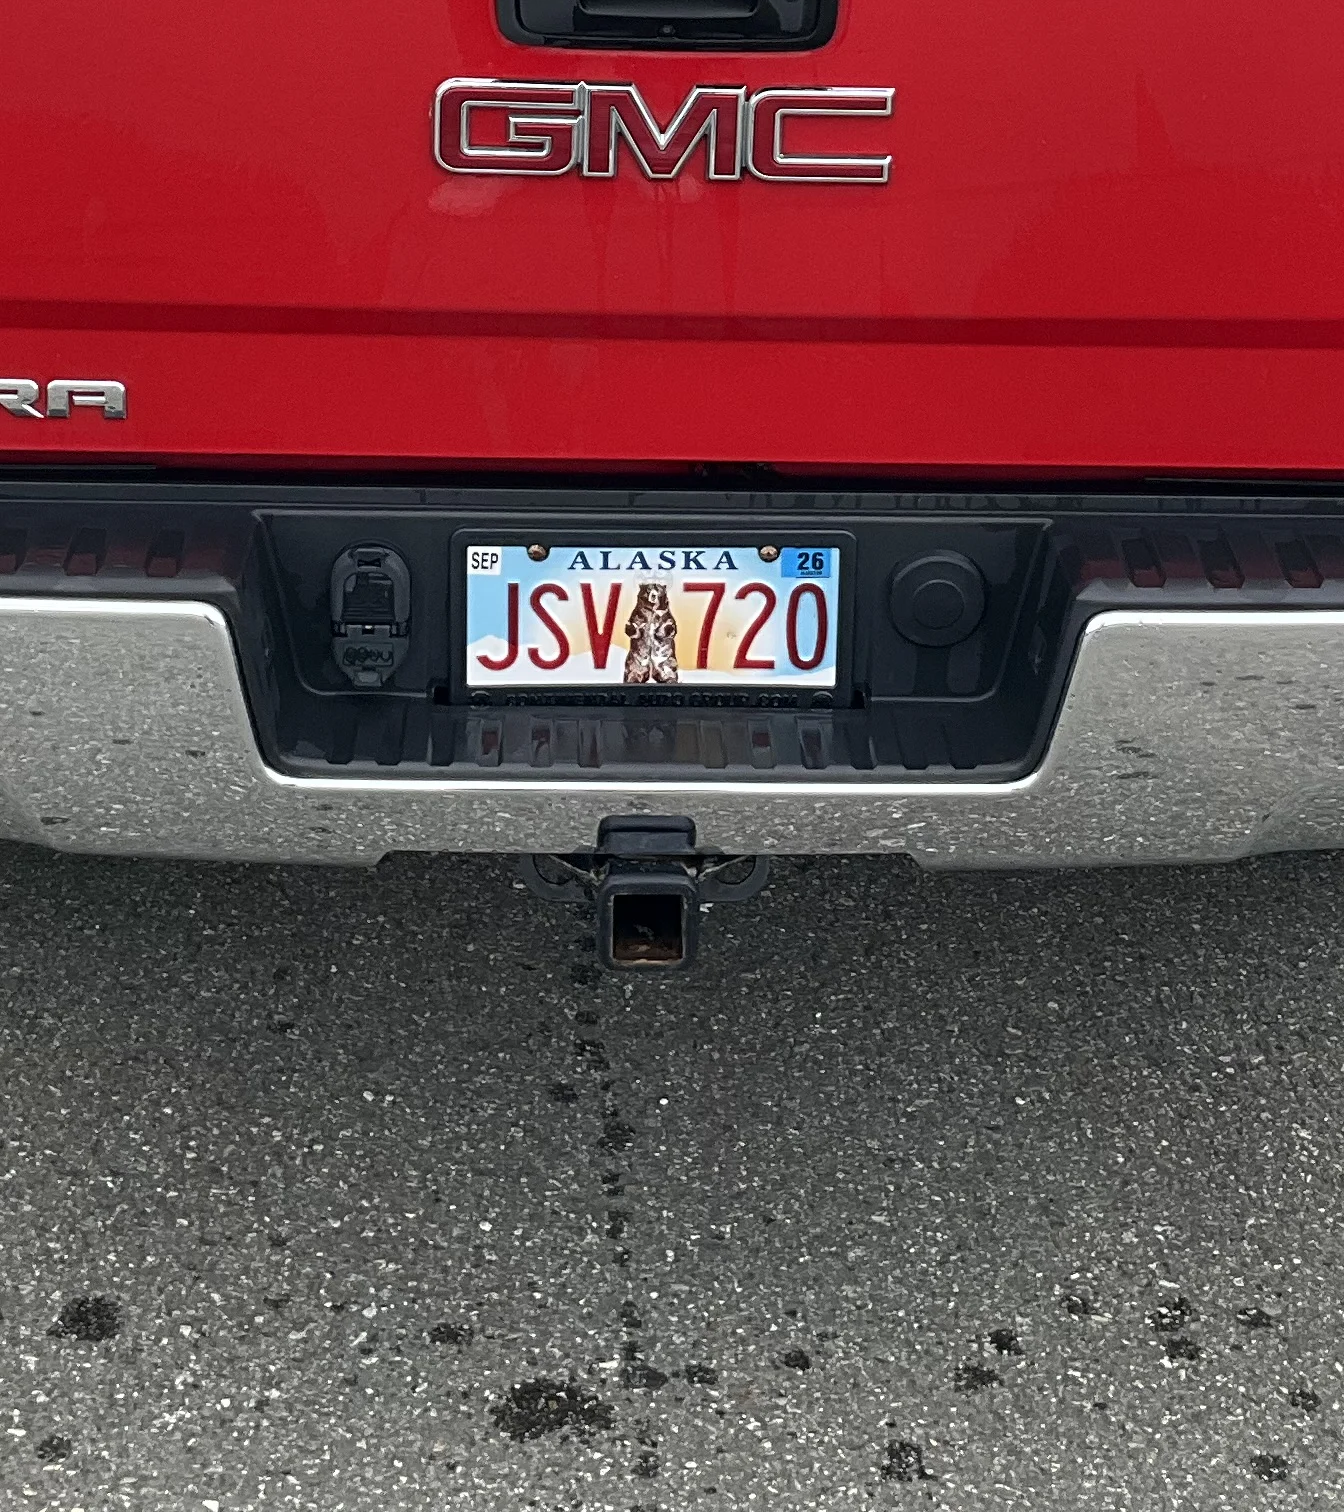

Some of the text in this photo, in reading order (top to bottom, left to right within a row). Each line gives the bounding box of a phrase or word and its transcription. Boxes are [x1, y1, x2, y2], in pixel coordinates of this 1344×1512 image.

[434, 77, 896, 184] GMC
[471, 551, 500, 570] SEP
[566, 550, 740, 571] ALASKA
[796, 551, 824, 571] 26
[476, 581, 830, 672] JSV 720
